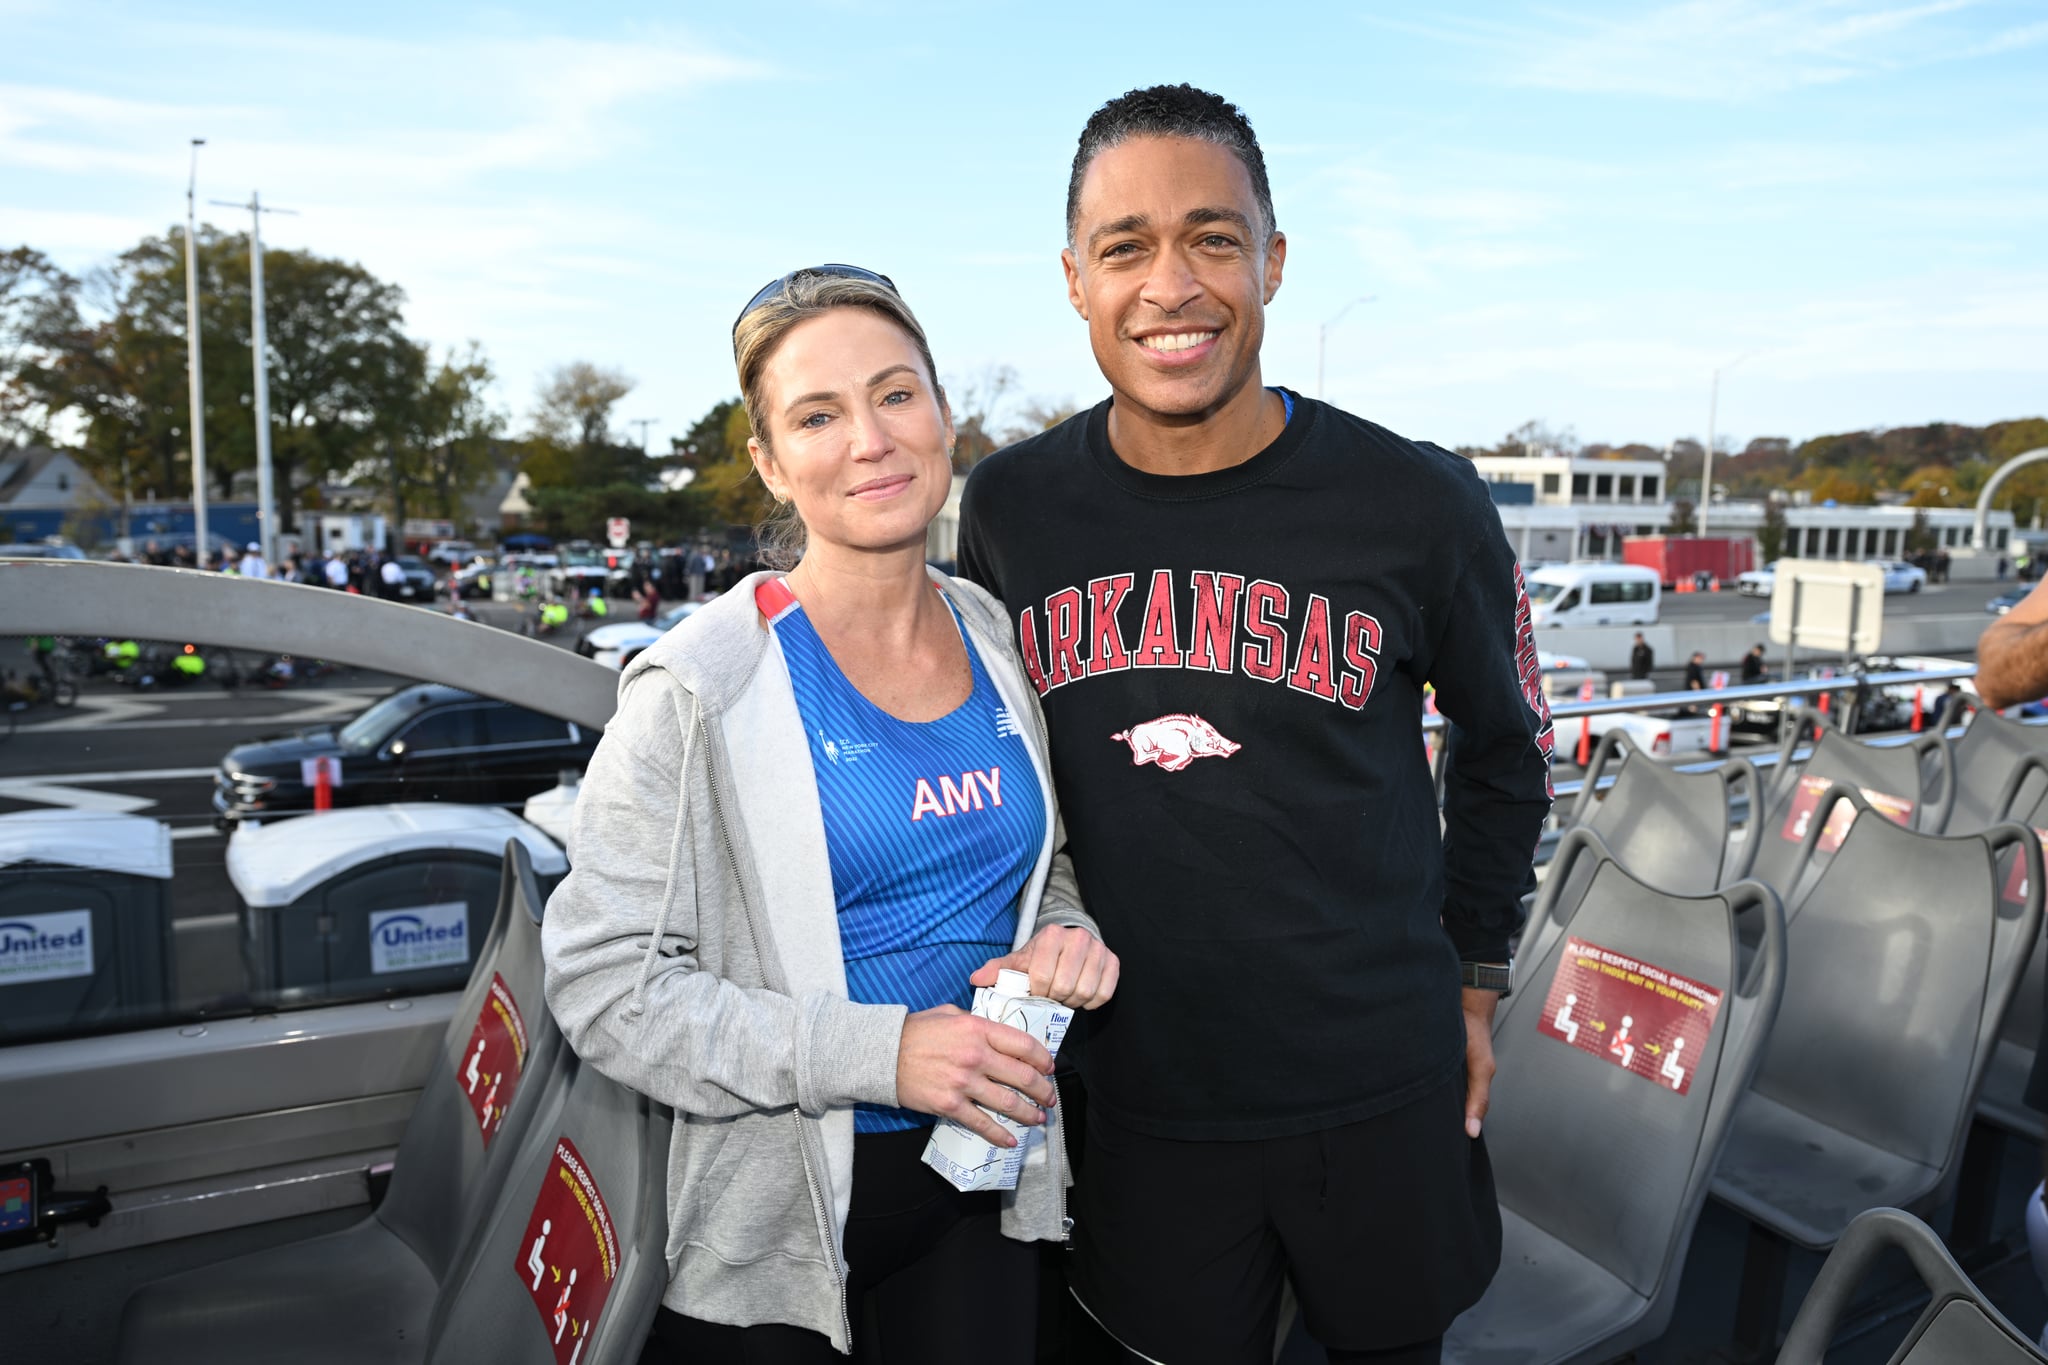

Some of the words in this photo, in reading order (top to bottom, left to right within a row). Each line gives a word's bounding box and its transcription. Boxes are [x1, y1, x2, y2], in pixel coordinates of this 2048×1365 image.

[1020, 569, 1384, 711] ARKANSAS
[911, 767, 1003, 822] AMY
[384, 918, 464, 947] United
[1568, 943, 1601, 960] PLEASE
[1602, 952, 1639, 972] RESPECT
[1639, 964, 1668, 984] SOCIAL
[1669, 976, 1719, 1006] DISTANCING
[1577, 958, 1601, 972] WITH
[1600, 964, 1627, 981] THOSE
[1627, 972, 1645, 986] NOT
[1645, 979, 1655, 991] IN
[1655, 984, 1678, 999] YOUR
[1677, 993, 1705, 1012] PARTY
[1050, 1012, 1069, 1023] flow
[557, 1144, 578, 1173] PLEASE
[576, 1165, 596, 1200] RESPECT
